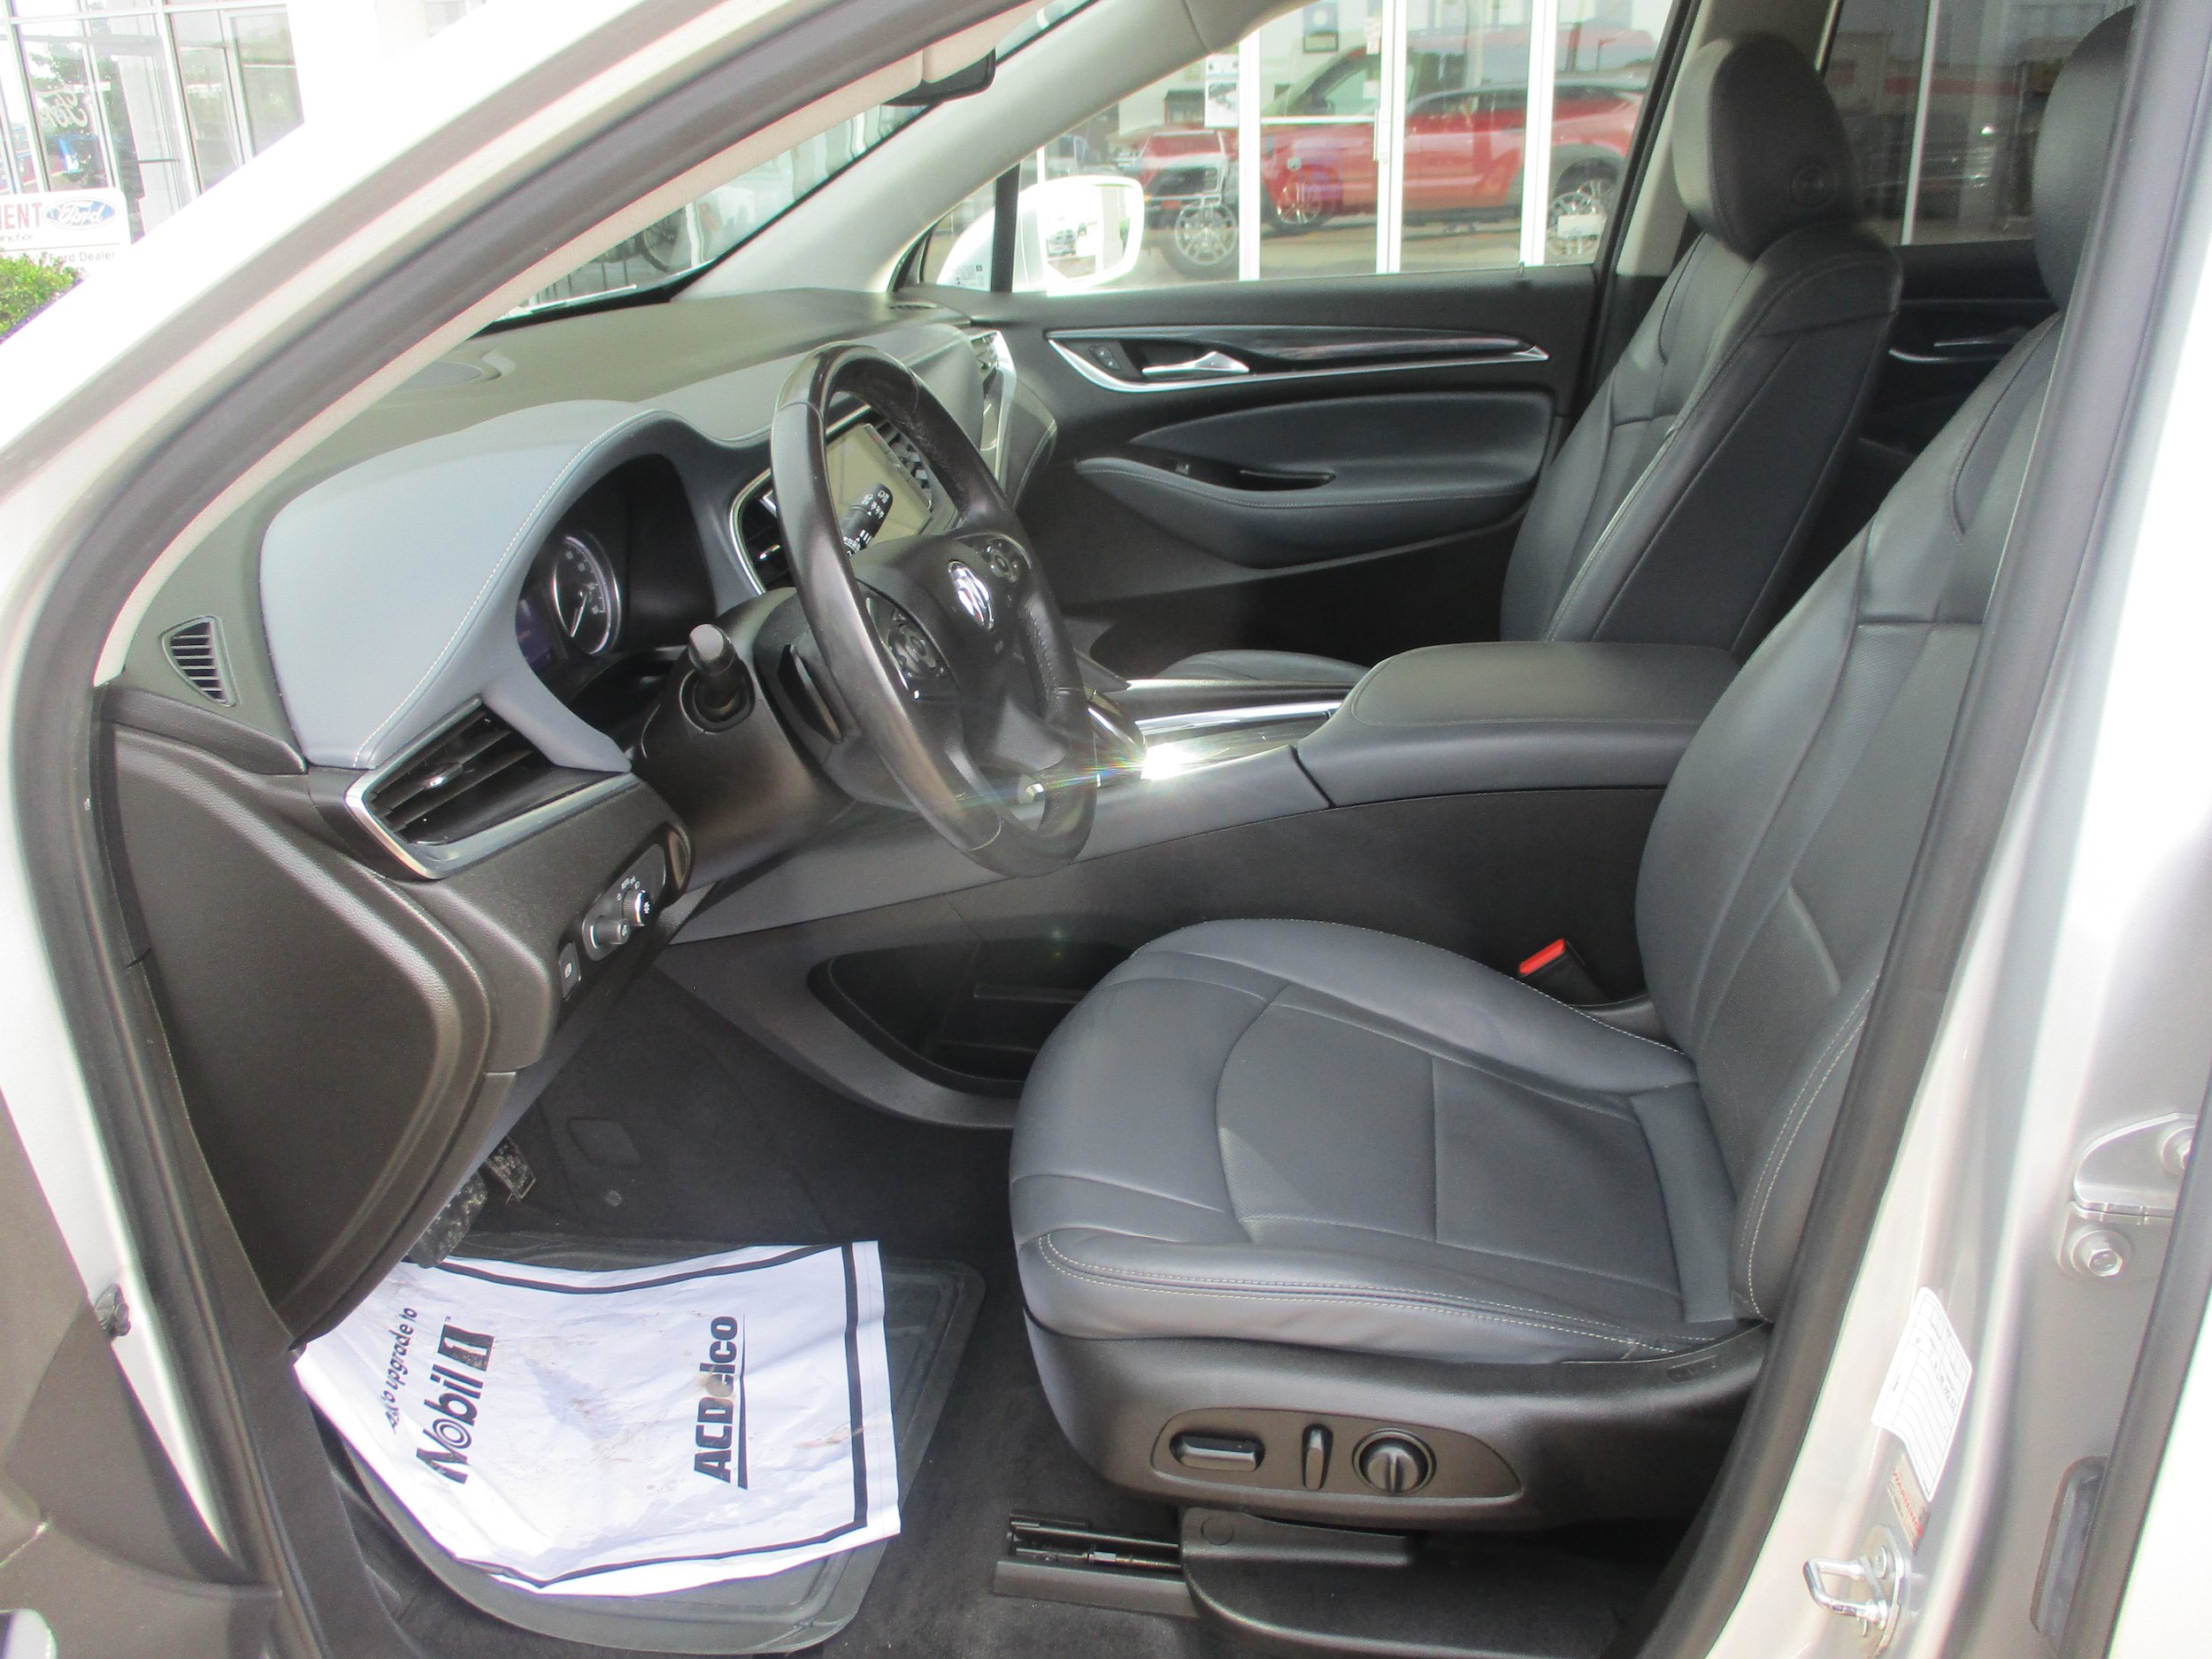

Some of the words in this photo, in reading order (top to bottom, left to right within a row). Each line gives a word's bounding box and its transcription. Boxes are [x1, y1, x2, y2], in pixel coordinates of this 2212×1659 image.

[0, 203, 42, 230] ENT
[80, 251, 115, 262] Dealer
[397, 1307, 419, 1323] to
[385, 1323, 415, 1389] upgrade
[694, 1316, 738, 1484] ACDelco
[415, 1363, 484, 1486] Mobil
